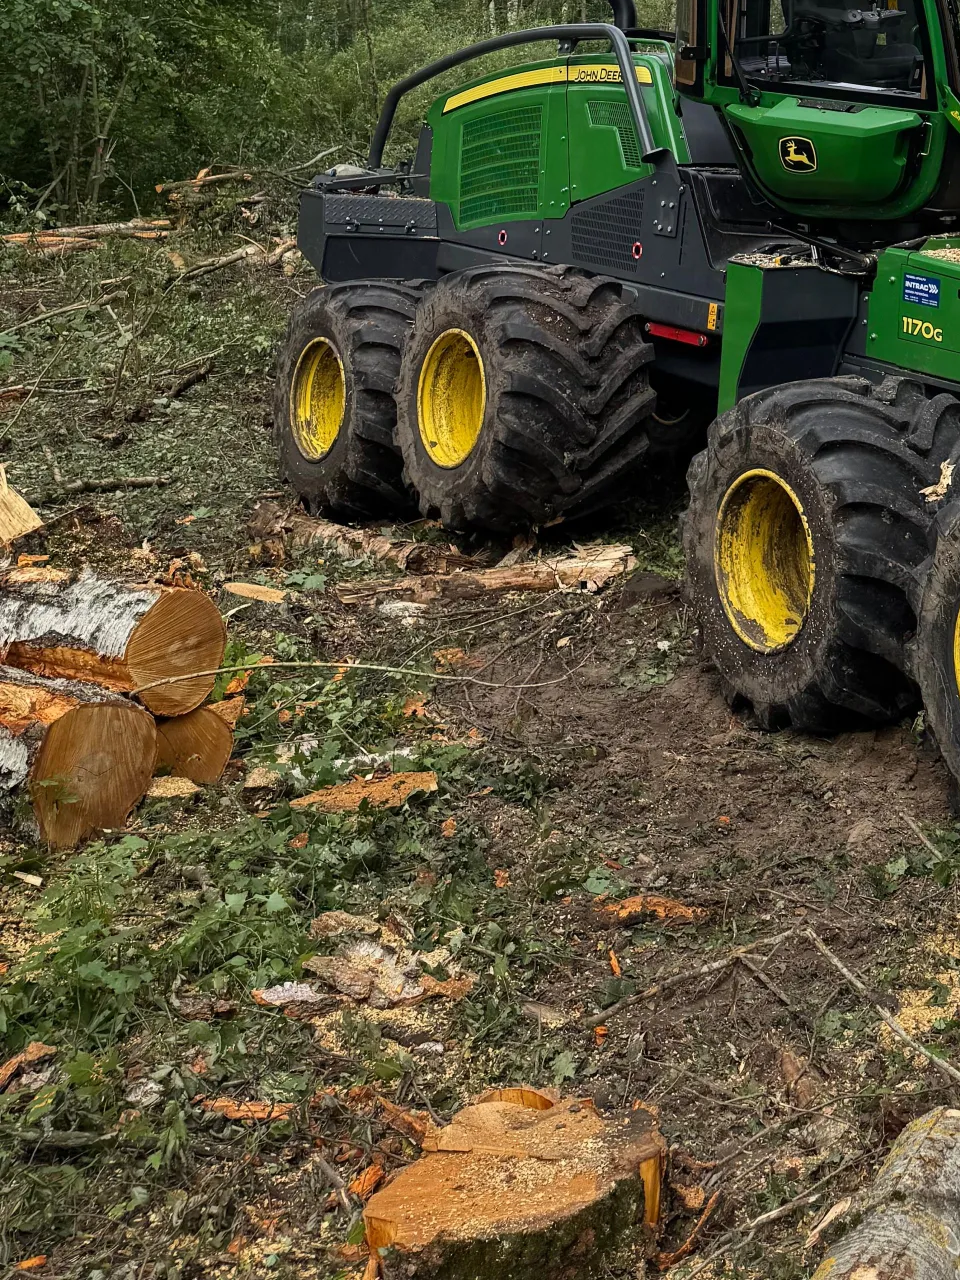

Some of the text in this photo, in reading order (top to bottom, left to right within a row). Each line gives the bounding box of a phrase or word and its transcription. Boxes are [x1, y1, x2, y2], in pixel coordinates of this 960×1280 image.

[574, 68, 598, 81] JOHN
[905, 280, 929, 292] INTRAC
[902, 316, 943, 342] 1170G
